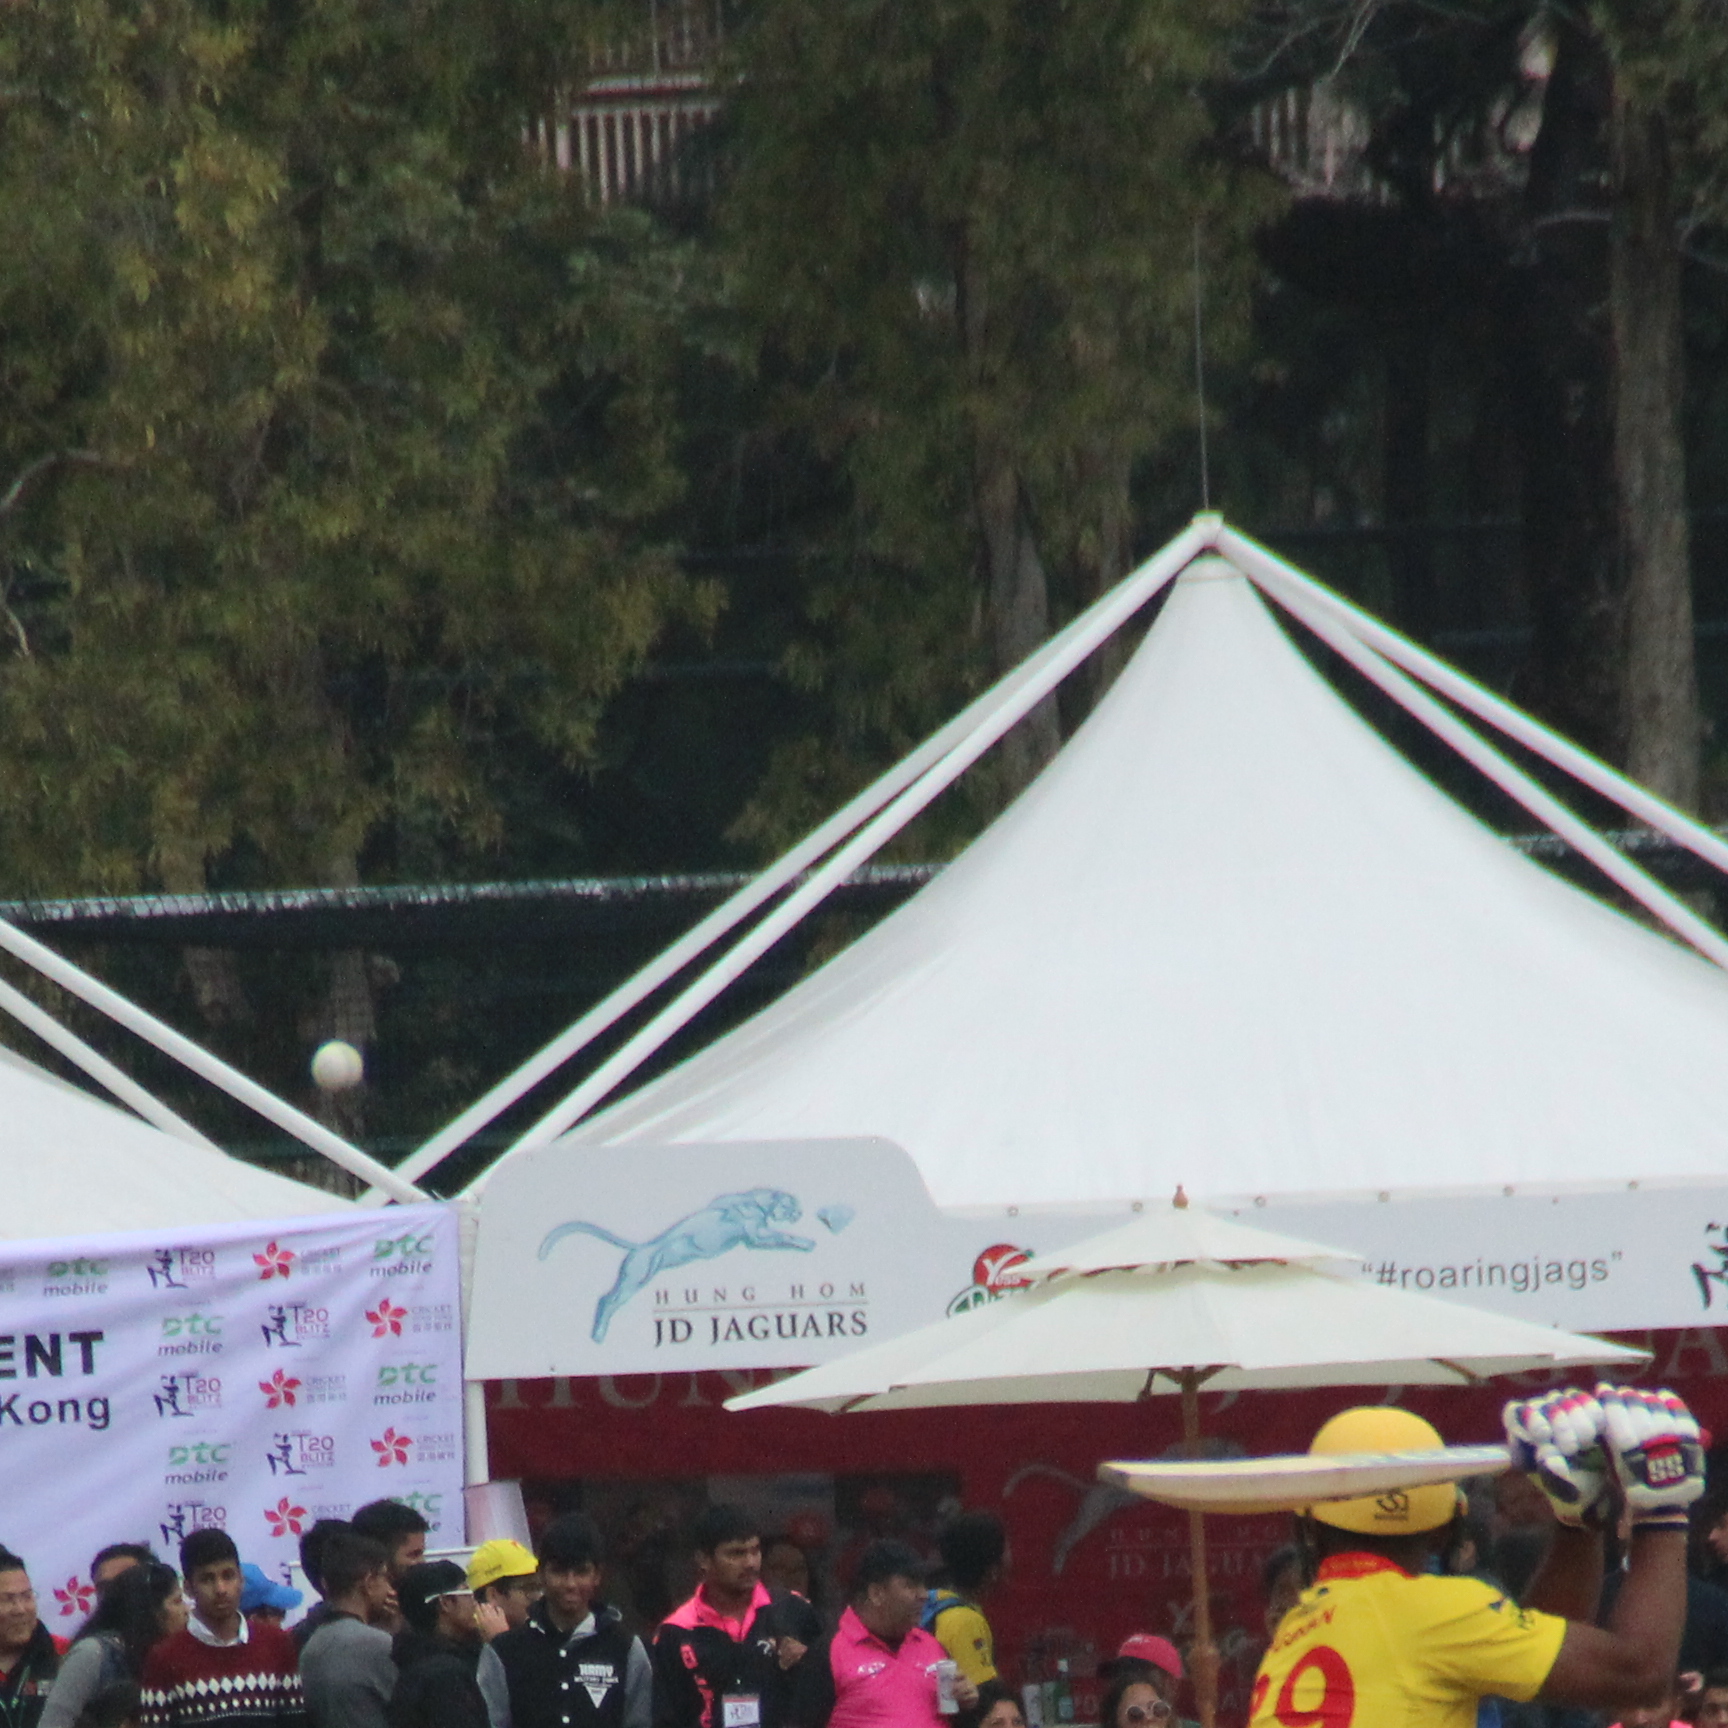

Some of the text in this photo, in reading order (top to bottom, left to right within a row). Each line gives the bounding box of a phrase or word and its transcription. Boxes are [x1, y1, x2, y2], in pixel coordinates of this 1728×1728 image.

[370, 1260, 433, 1279] mobile
[654, 1281, 868, 1305] HUNG HOM
[653, 1311, 870, 1348] JD JAGUARS
[157, 1339, 224, 1358] mobile
[374, 1388, 437, 1406] mobile
[165, 1468, 229, 1486] mobile
